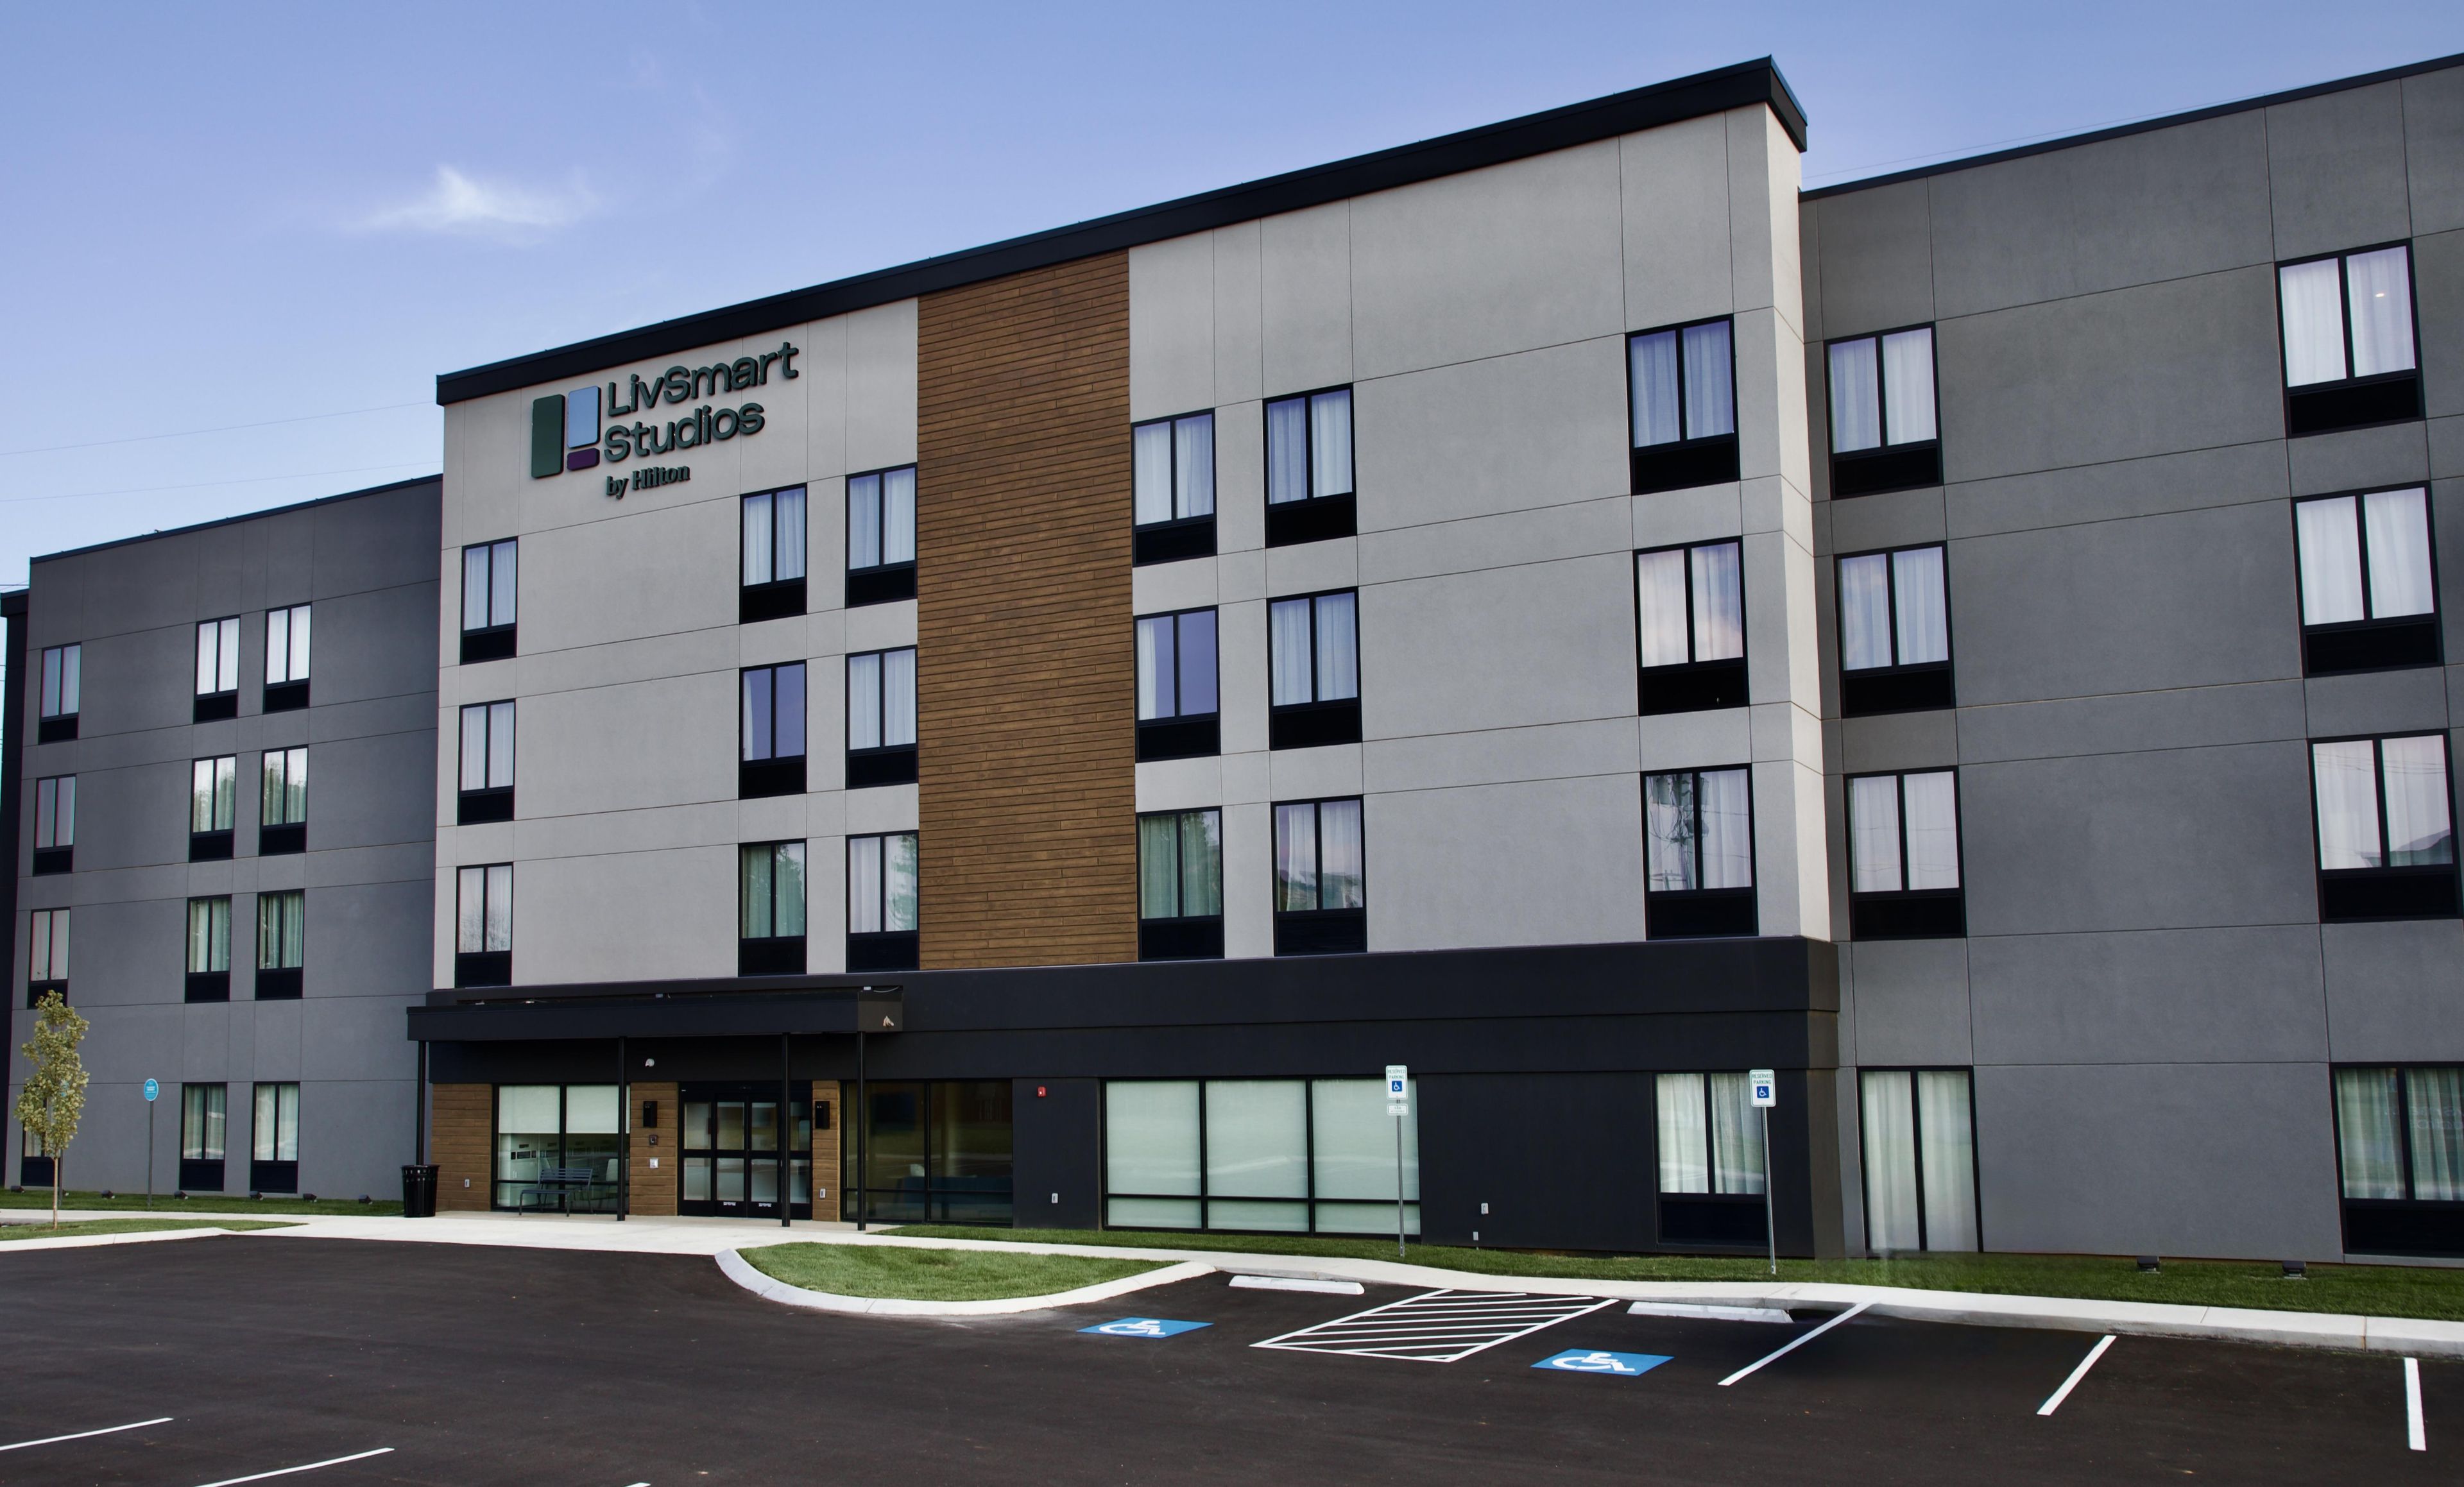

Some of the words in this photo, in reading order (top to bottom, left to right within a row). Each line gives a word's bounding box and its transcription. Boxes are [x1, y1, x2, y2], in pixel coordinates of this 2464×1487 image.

[608, 341, 799, 417] LivSmart
[604, 402, 765, 462] Studios
[606, 475, 628, 499] by
[631, 465, 690, 491] Hilton
